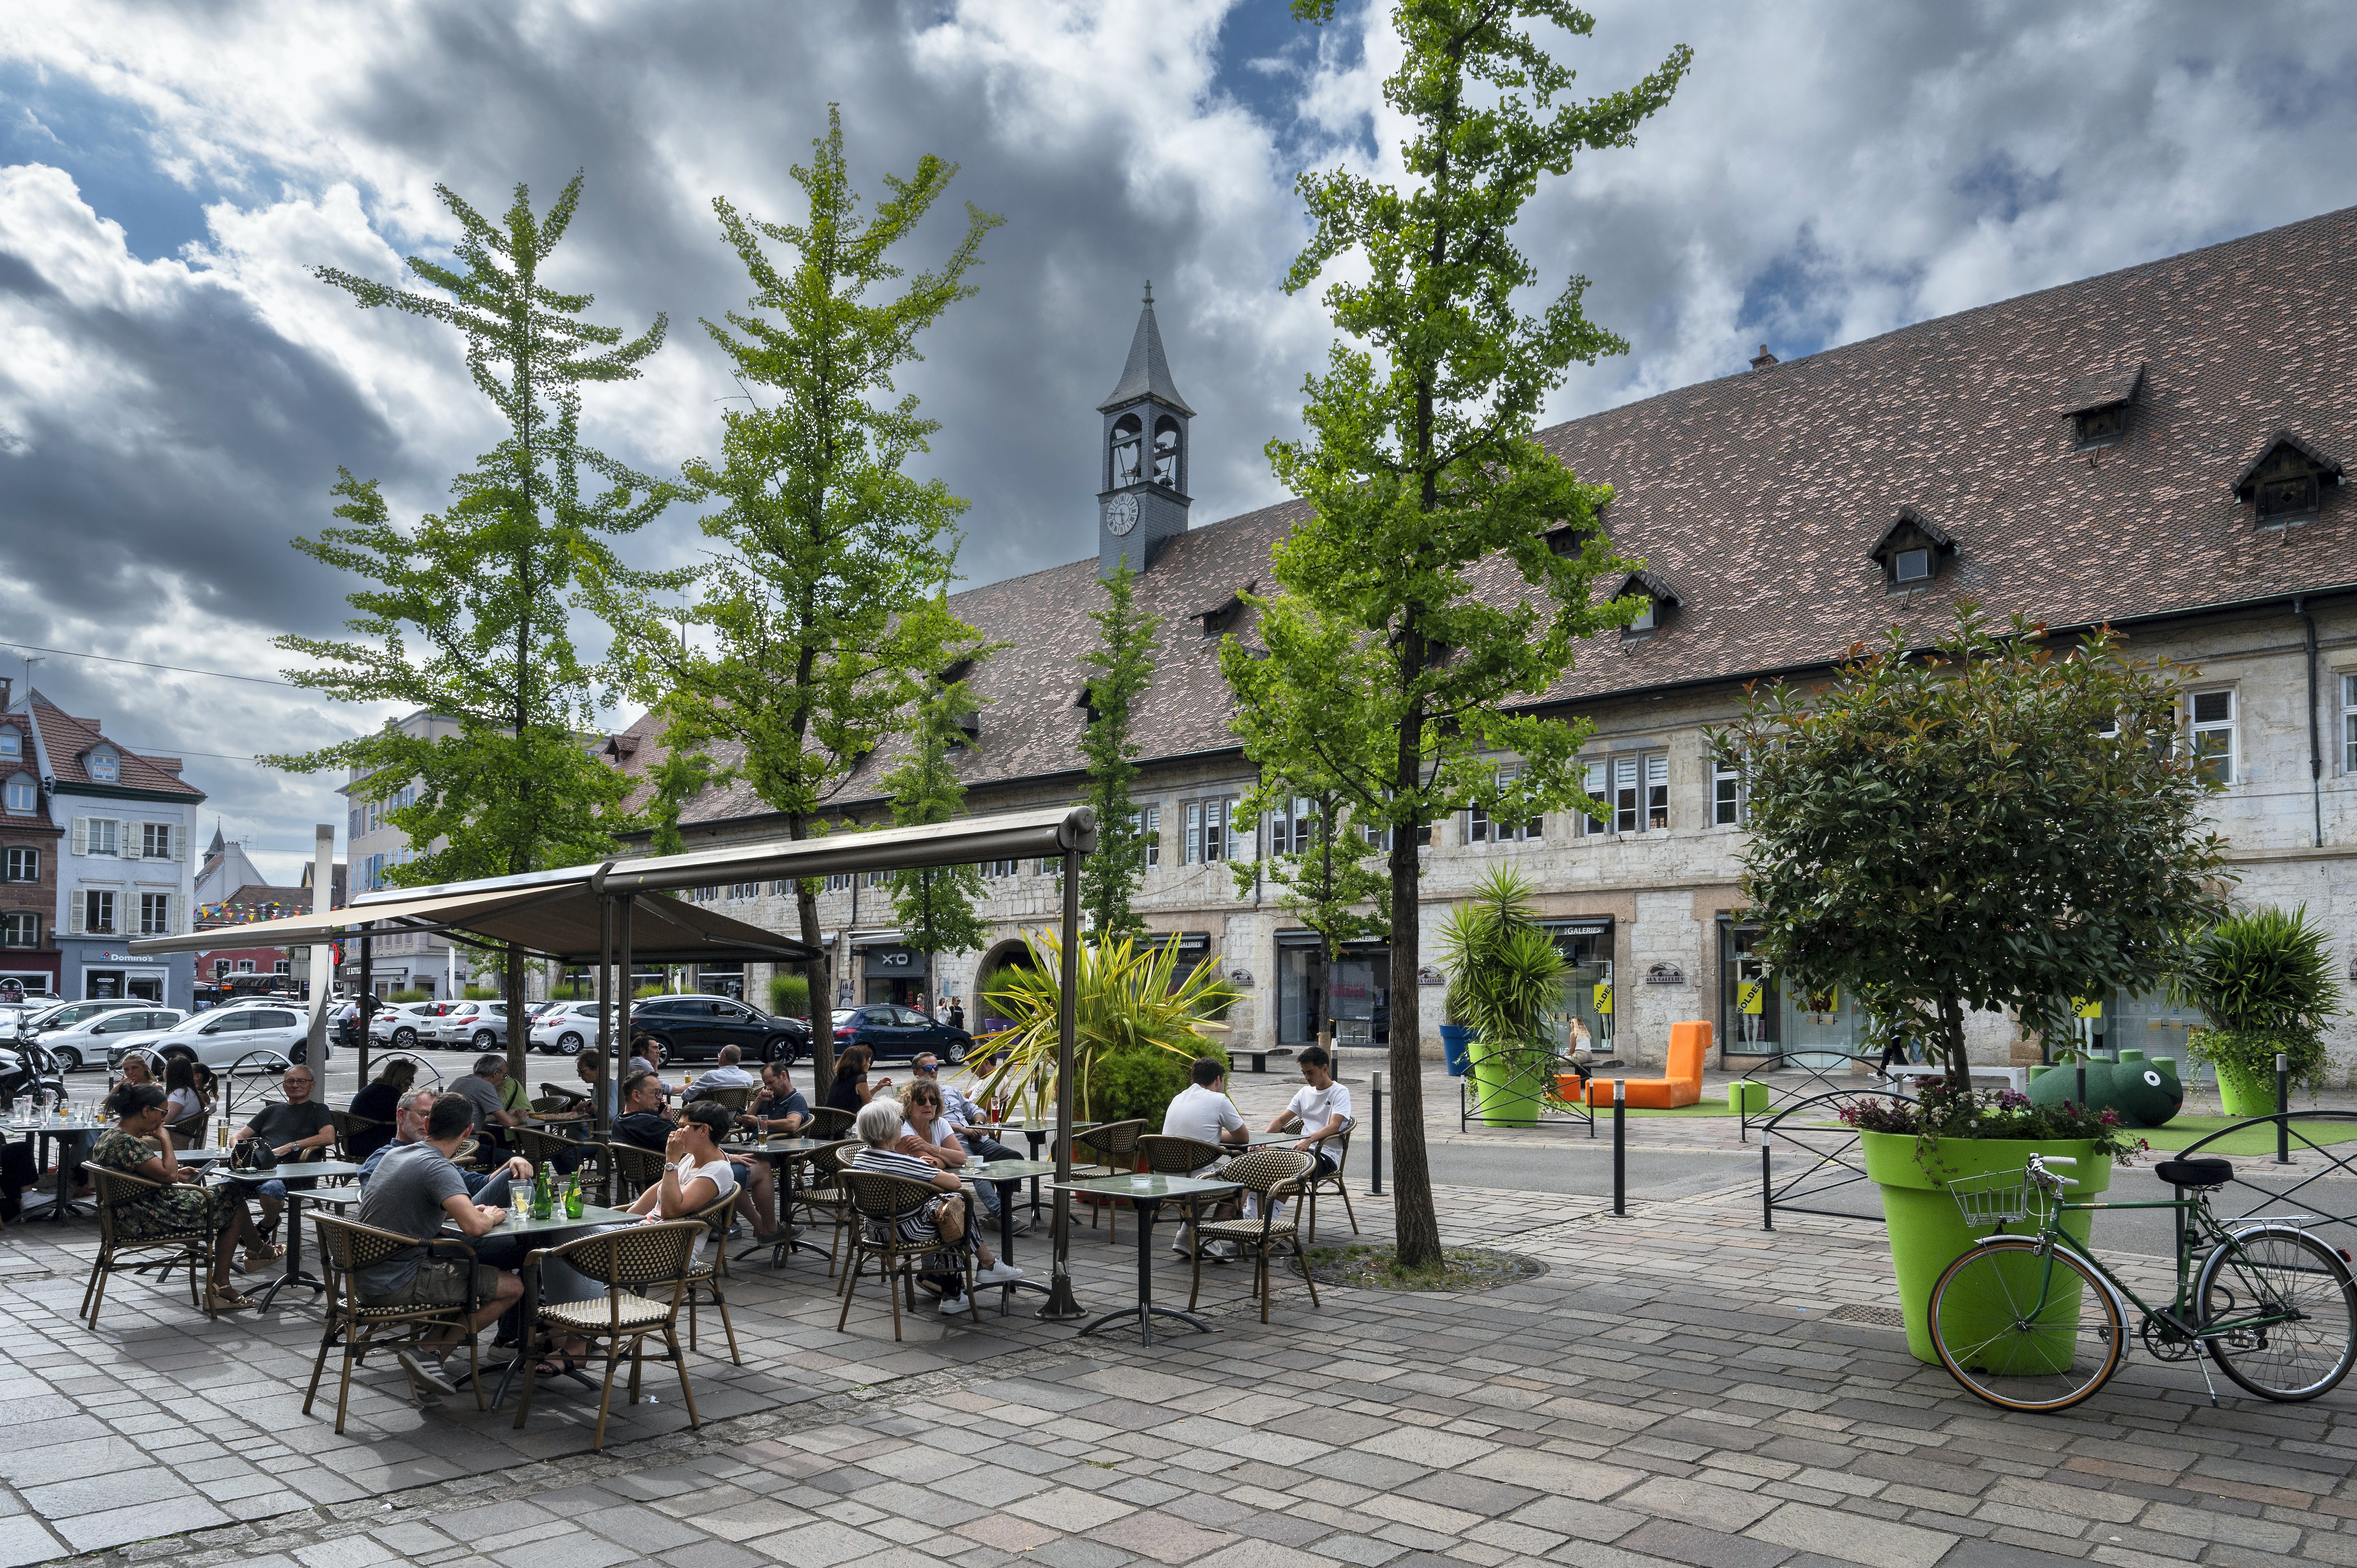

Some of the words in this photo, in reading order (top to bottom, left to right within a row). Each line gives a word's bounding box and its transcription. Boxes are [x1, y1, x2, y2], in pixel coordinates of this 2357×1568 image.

[1593, 984, 1612, 1014] SOLDES
[1738, 982, 1762, 1014] SOLDES
[2071, 1000, 2088, 1018] SOL
